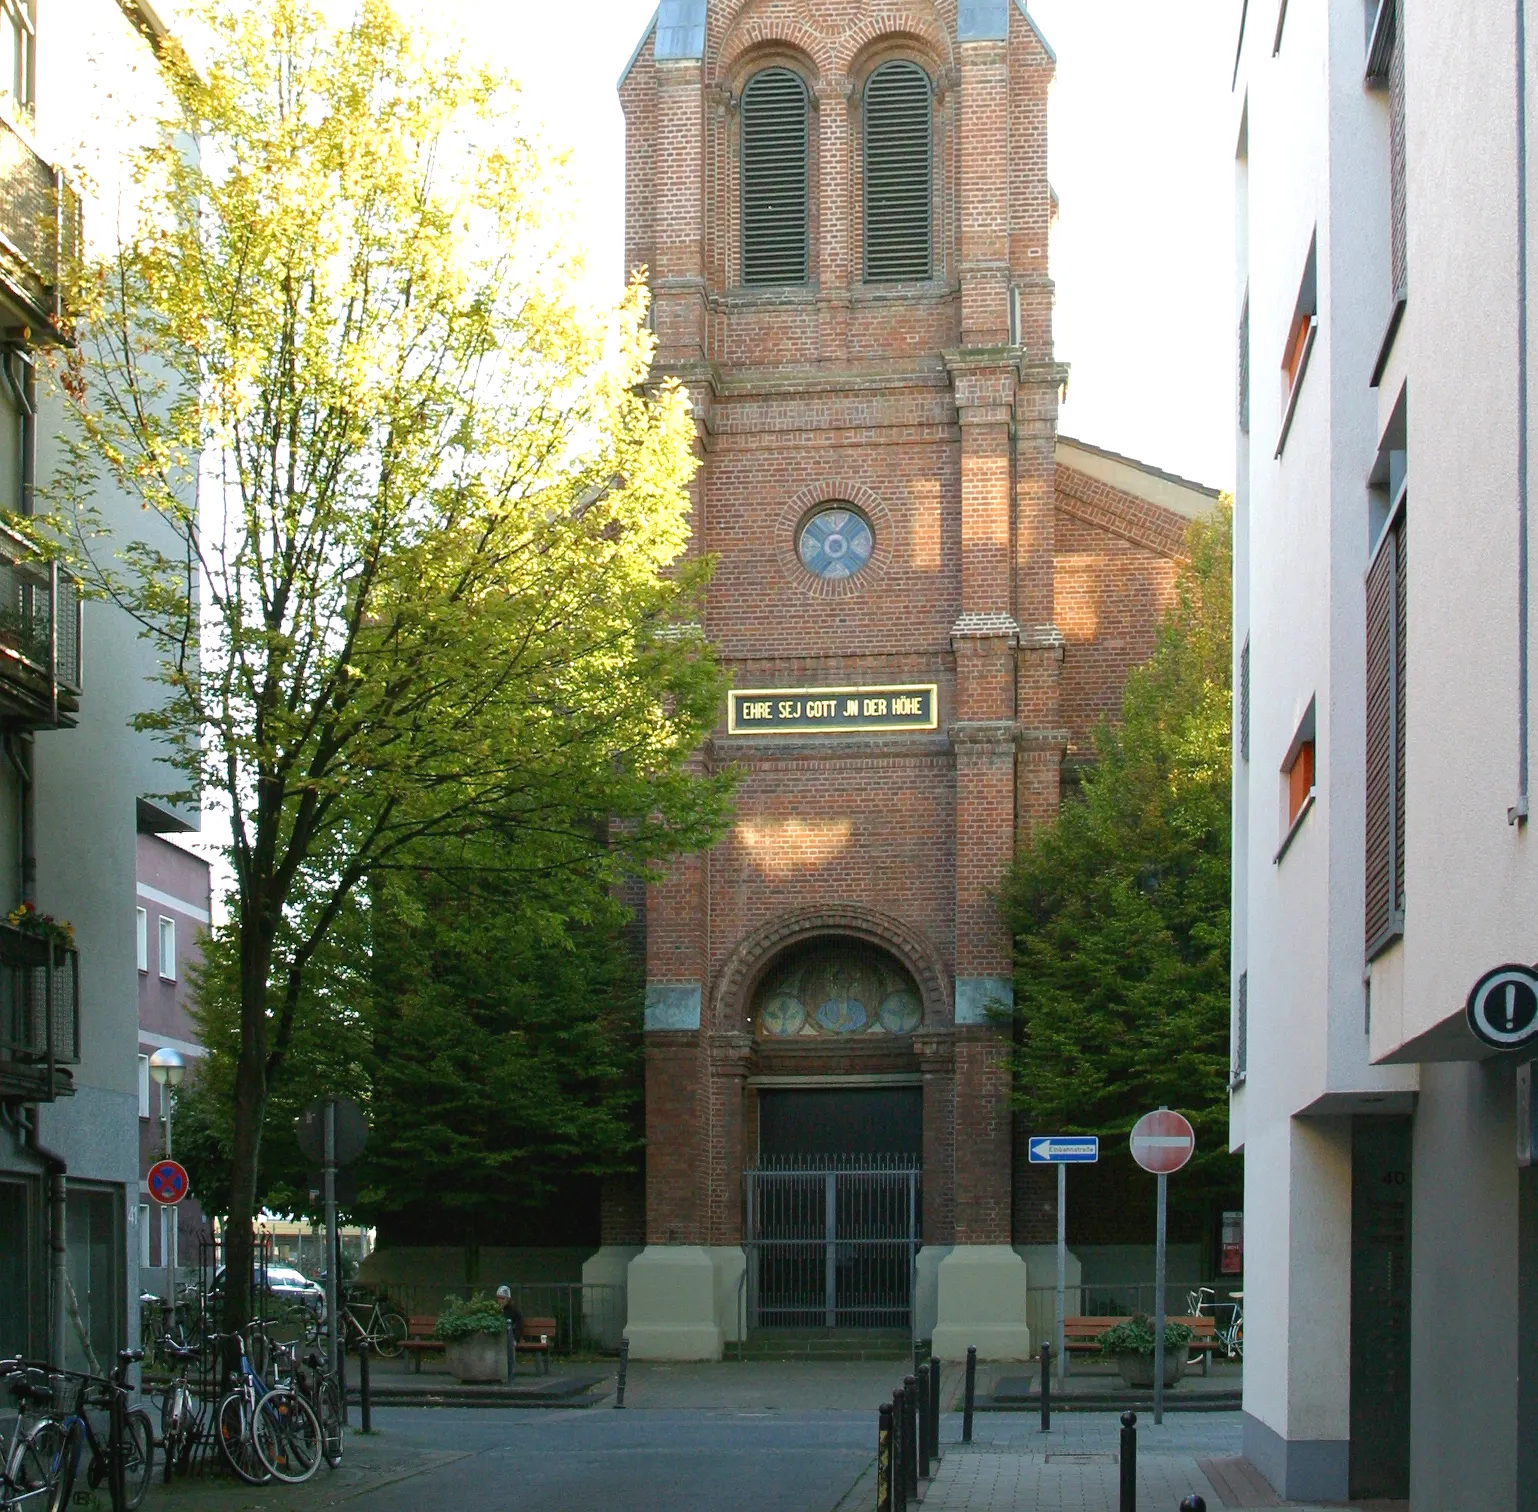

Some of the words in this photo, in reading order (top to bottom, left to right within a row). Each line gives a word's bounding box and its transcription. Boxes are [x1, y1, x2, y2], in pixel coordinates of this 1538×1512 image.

[743, 702, 773, 719] EHRE
[806, 700, 837, 717] GOTT
[863, 698, 887, 716] DER
[891, 695, 922, 715] HÖHE
